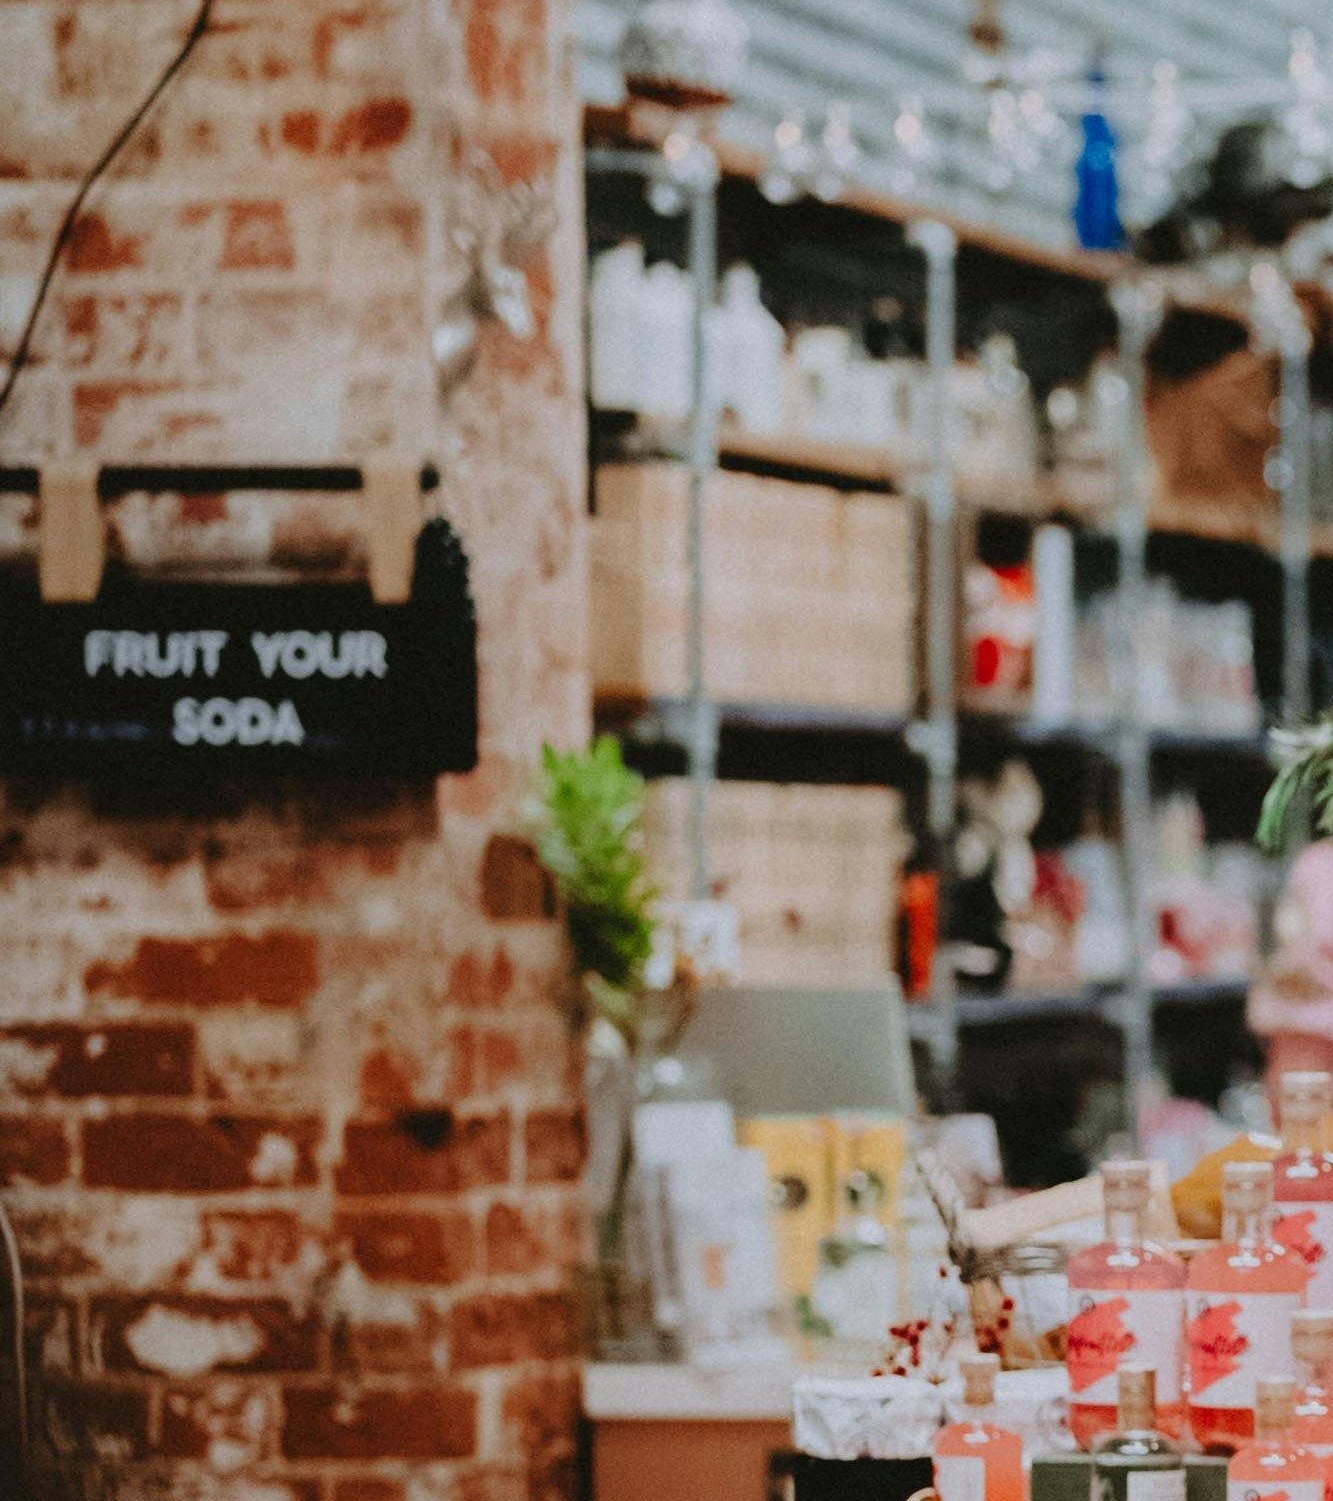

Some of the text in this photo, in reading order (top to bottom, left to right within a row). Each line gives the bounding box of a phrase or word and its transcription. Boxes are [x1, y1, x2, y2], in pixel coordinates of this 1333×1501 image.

[84, 629, 389, 680] FRUIT YOUR
[171, 696, 306, 747] SODA
